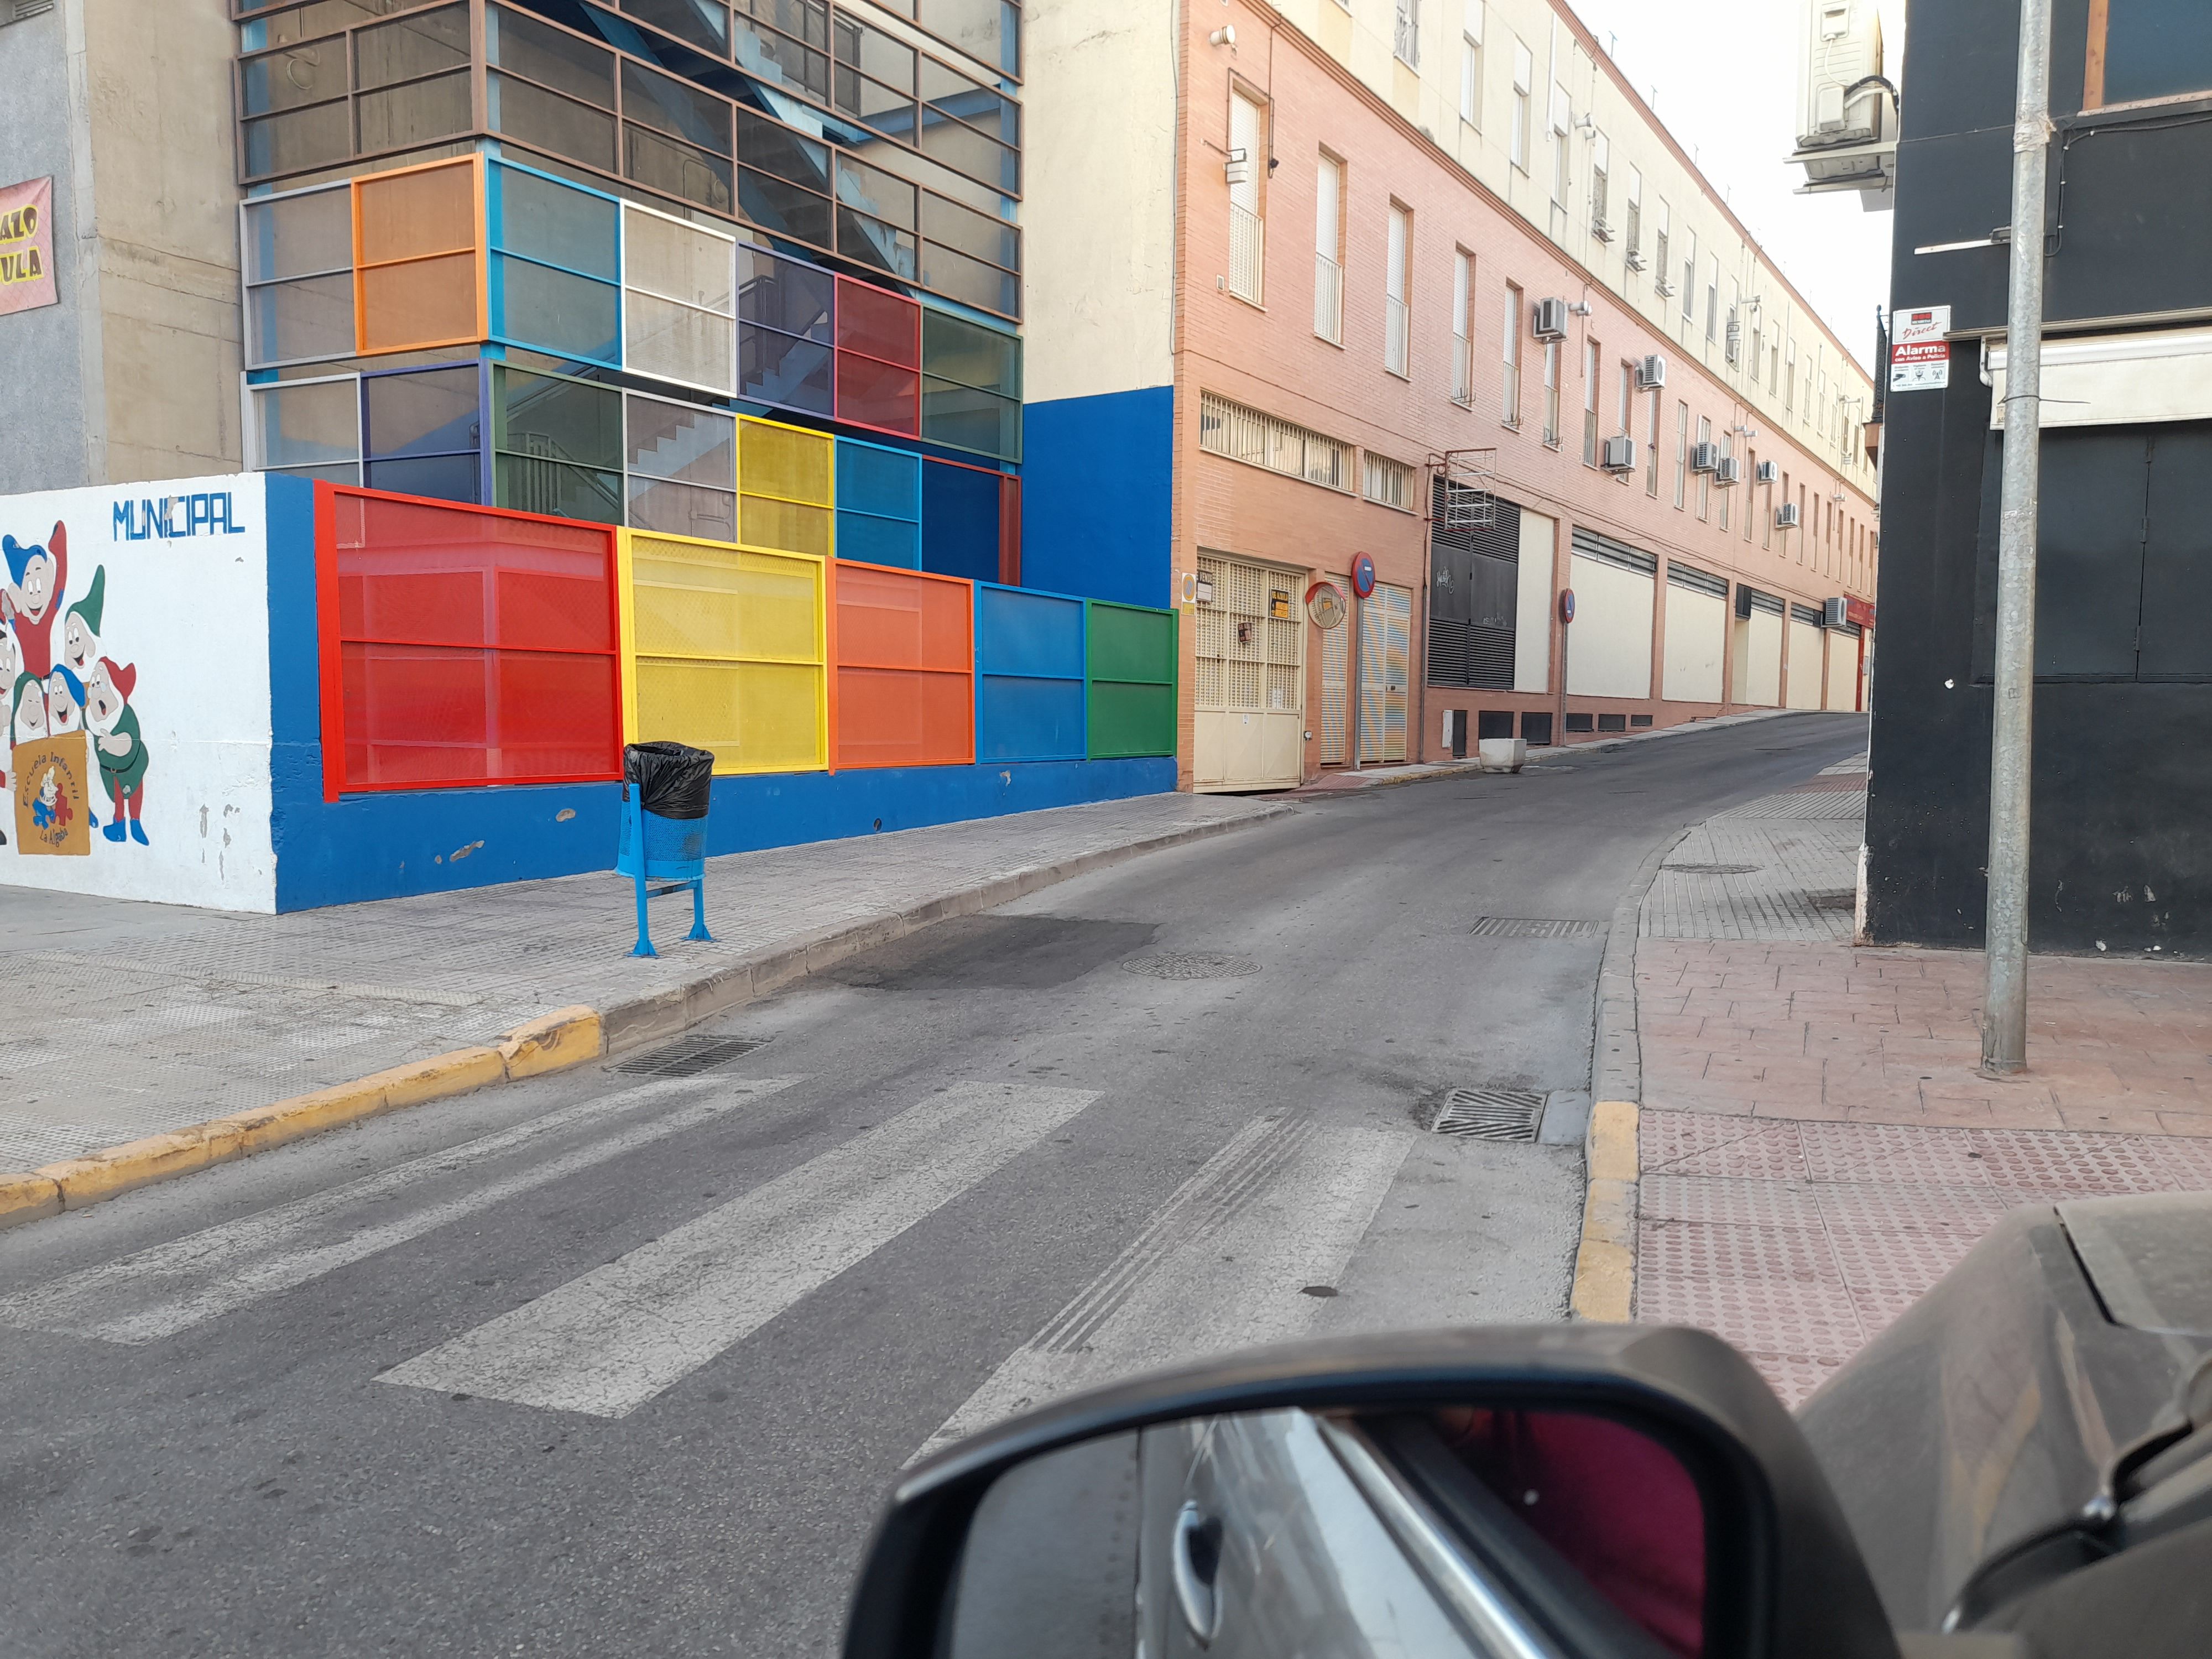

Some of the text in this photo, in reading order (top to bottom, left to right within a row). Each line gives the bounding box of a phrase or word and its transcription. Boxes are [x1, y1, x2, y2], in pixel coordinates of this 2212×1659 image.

[1902, 321, 1942, 340] Direct
[1895, 345, 1945, 356] Alarma
[113, 492, 246, 541] MUNICIPAL
[23, 755, 46, 808] Escuela
[40, 830, 48, 843] La
